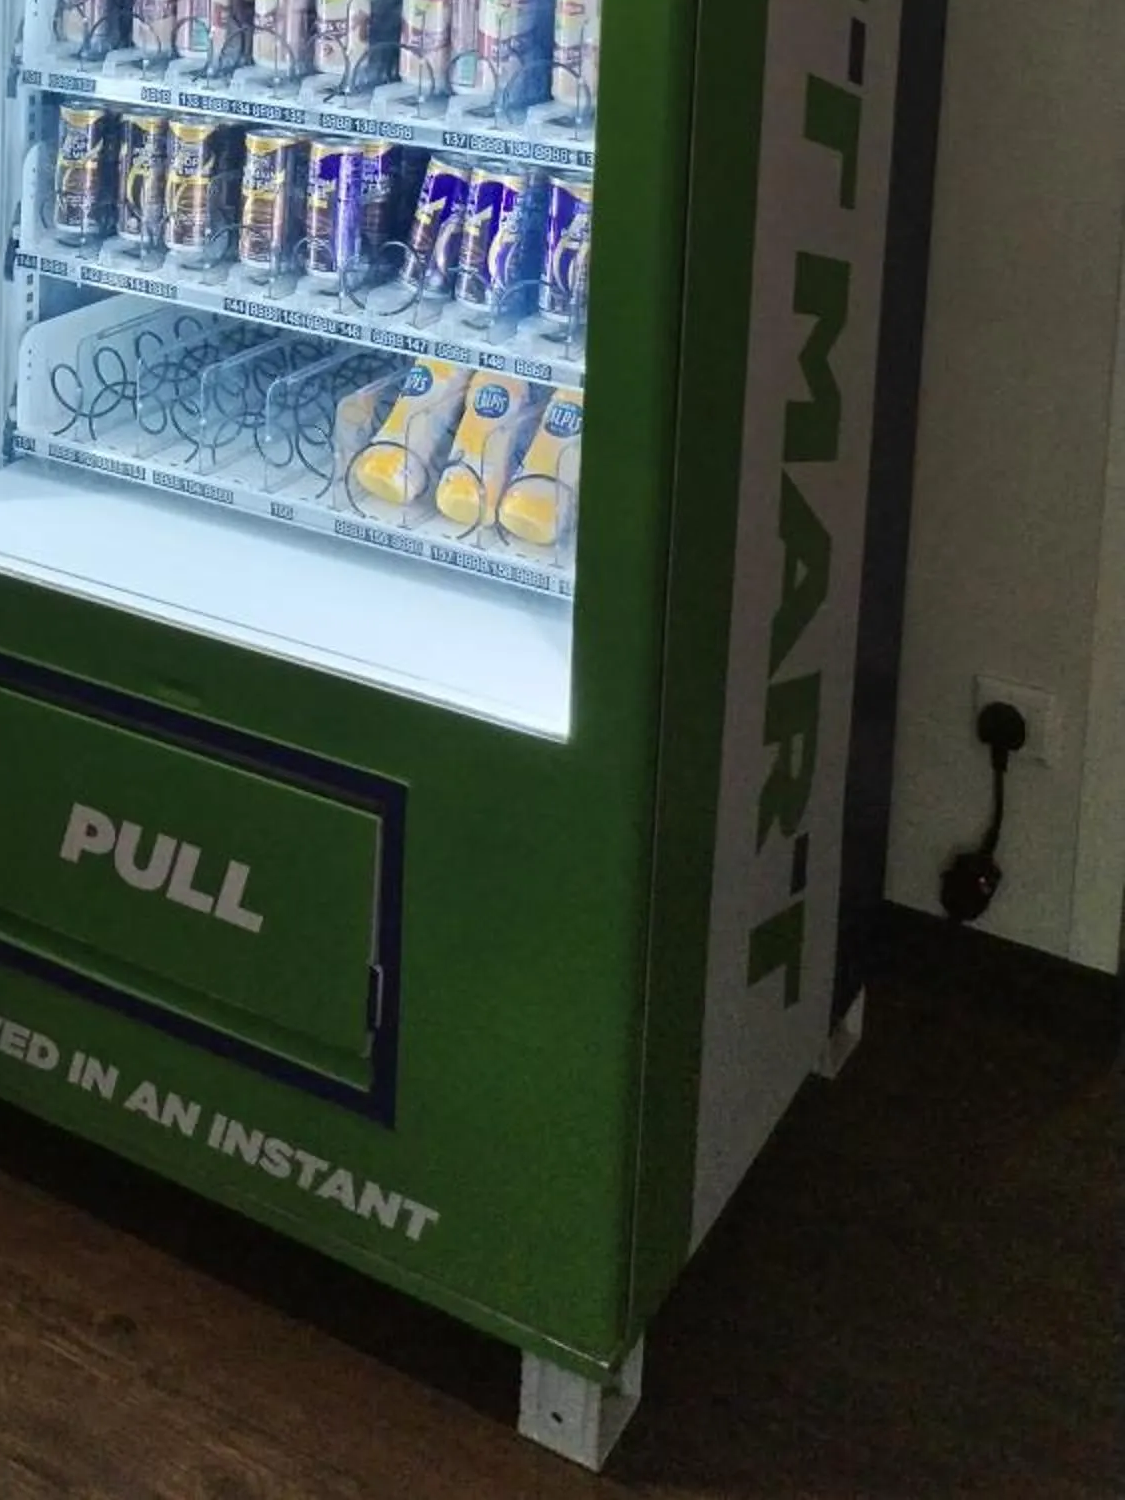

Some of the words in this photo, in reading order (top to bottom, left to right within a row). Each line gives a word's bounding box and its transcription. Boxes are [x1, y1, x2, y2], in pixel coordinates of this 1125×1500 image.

[747, 249, 851, 1011] MART
[60, 802, 264, 933] PULL
[68, 1051, 119, 1100] IN
[124, 1080, 202, 1136] AN
[207, 1114, 441, 1242] INSTANT
